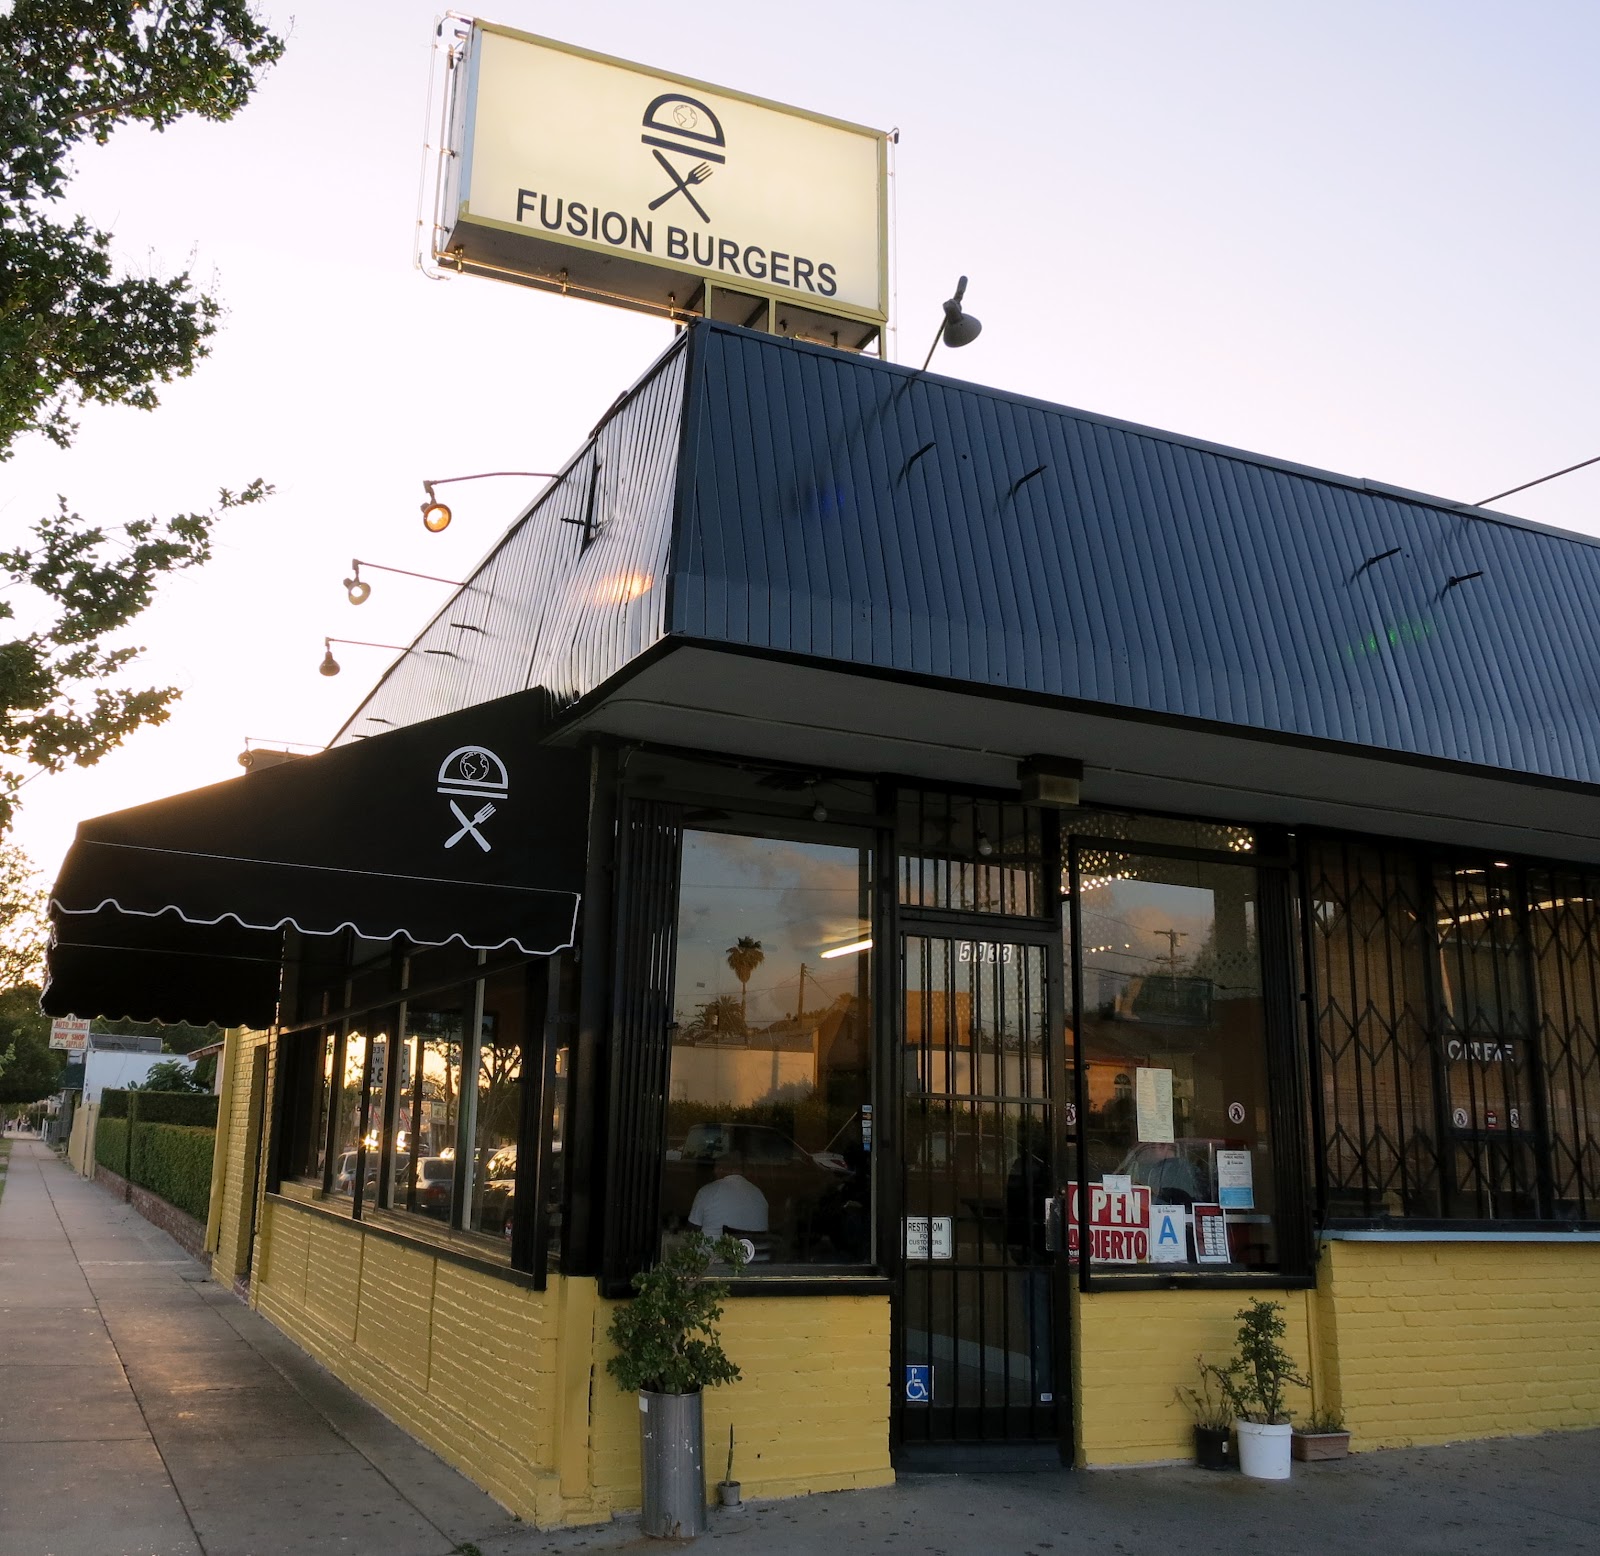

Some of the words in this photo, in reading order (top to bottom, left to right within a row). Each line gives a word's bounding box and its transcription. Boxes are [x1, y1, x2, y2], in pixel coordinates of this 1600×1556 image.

[516, 188, 652, 251] FUSION
[667, 227, 838, 297] BURGERS
[908, 1222, 943, 1232] RESTROM
[1158, 1215, 1179, 1244] A
